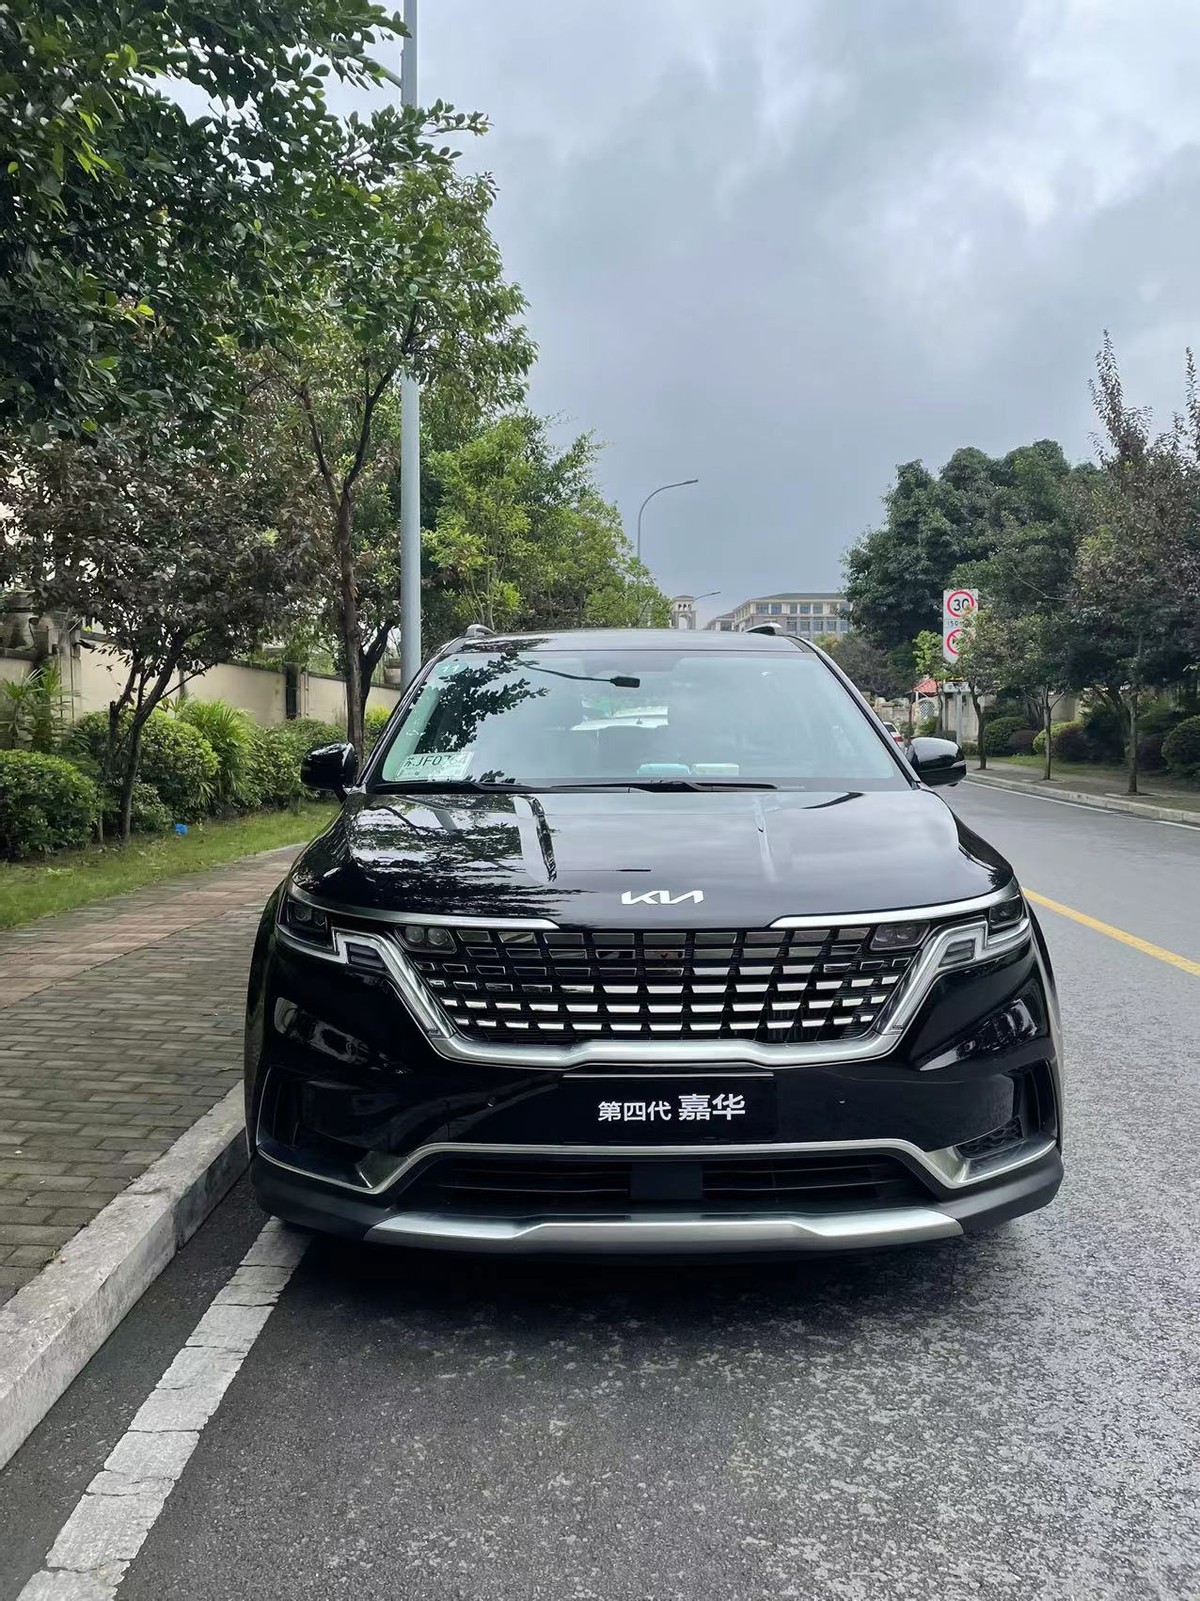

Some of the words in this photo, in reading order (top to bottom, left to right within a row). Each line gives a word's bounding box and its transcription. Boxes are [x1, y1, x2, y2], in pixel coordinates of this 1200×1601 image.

[953, 598, 970, 611] 30
[621, 890, 704, 905] KIA
[597, 1100, 672, 1122] 第四代
[678, 1093, 746, 1121] 嘉华
